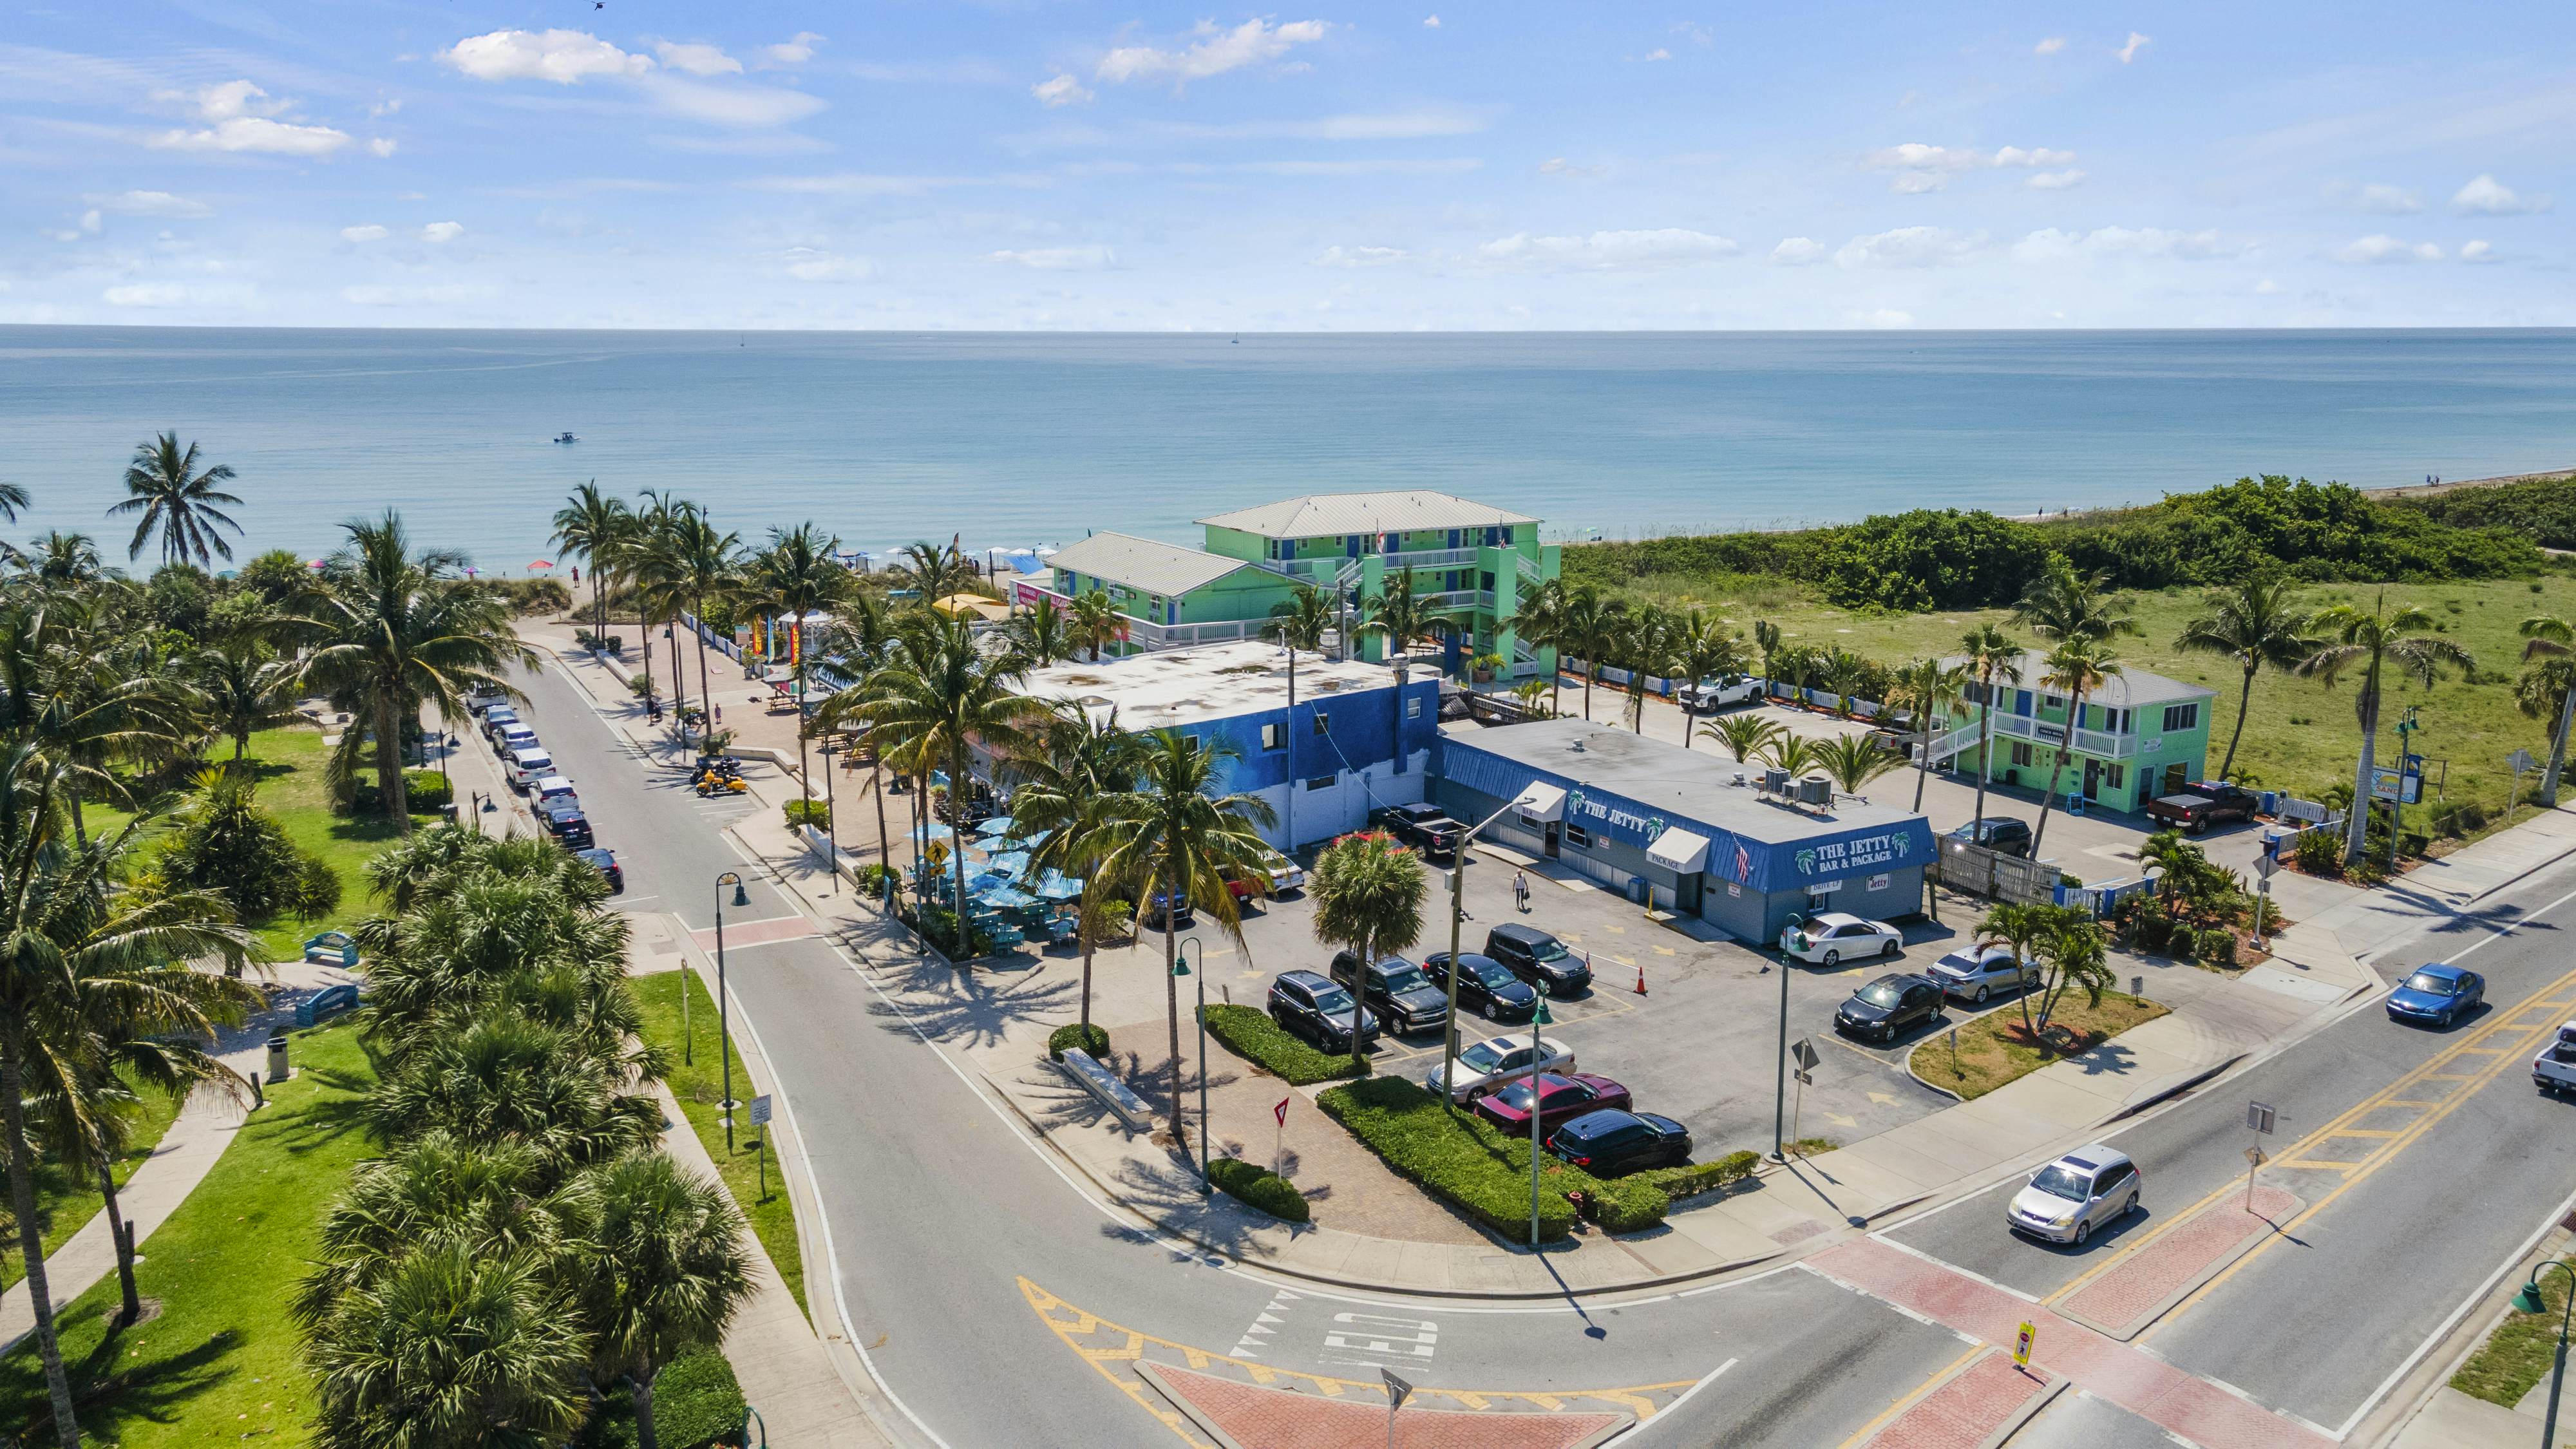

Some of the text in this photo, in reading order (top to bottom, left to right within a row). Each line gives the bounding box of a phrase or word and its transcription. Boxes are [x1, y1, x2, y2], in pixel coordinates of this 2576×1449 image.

[1522, 808, 1533, 817] BAR
[1584, 800, 1647, 833] THE JETTY
[1817, 835, 1889, 860] THE JETTY
[1652, 854, 1680, 869] PACKAGE
[1819, 851, 1891, 873] BAR & PACKAGE
[1870, 878, 1887, 888] Jetty
